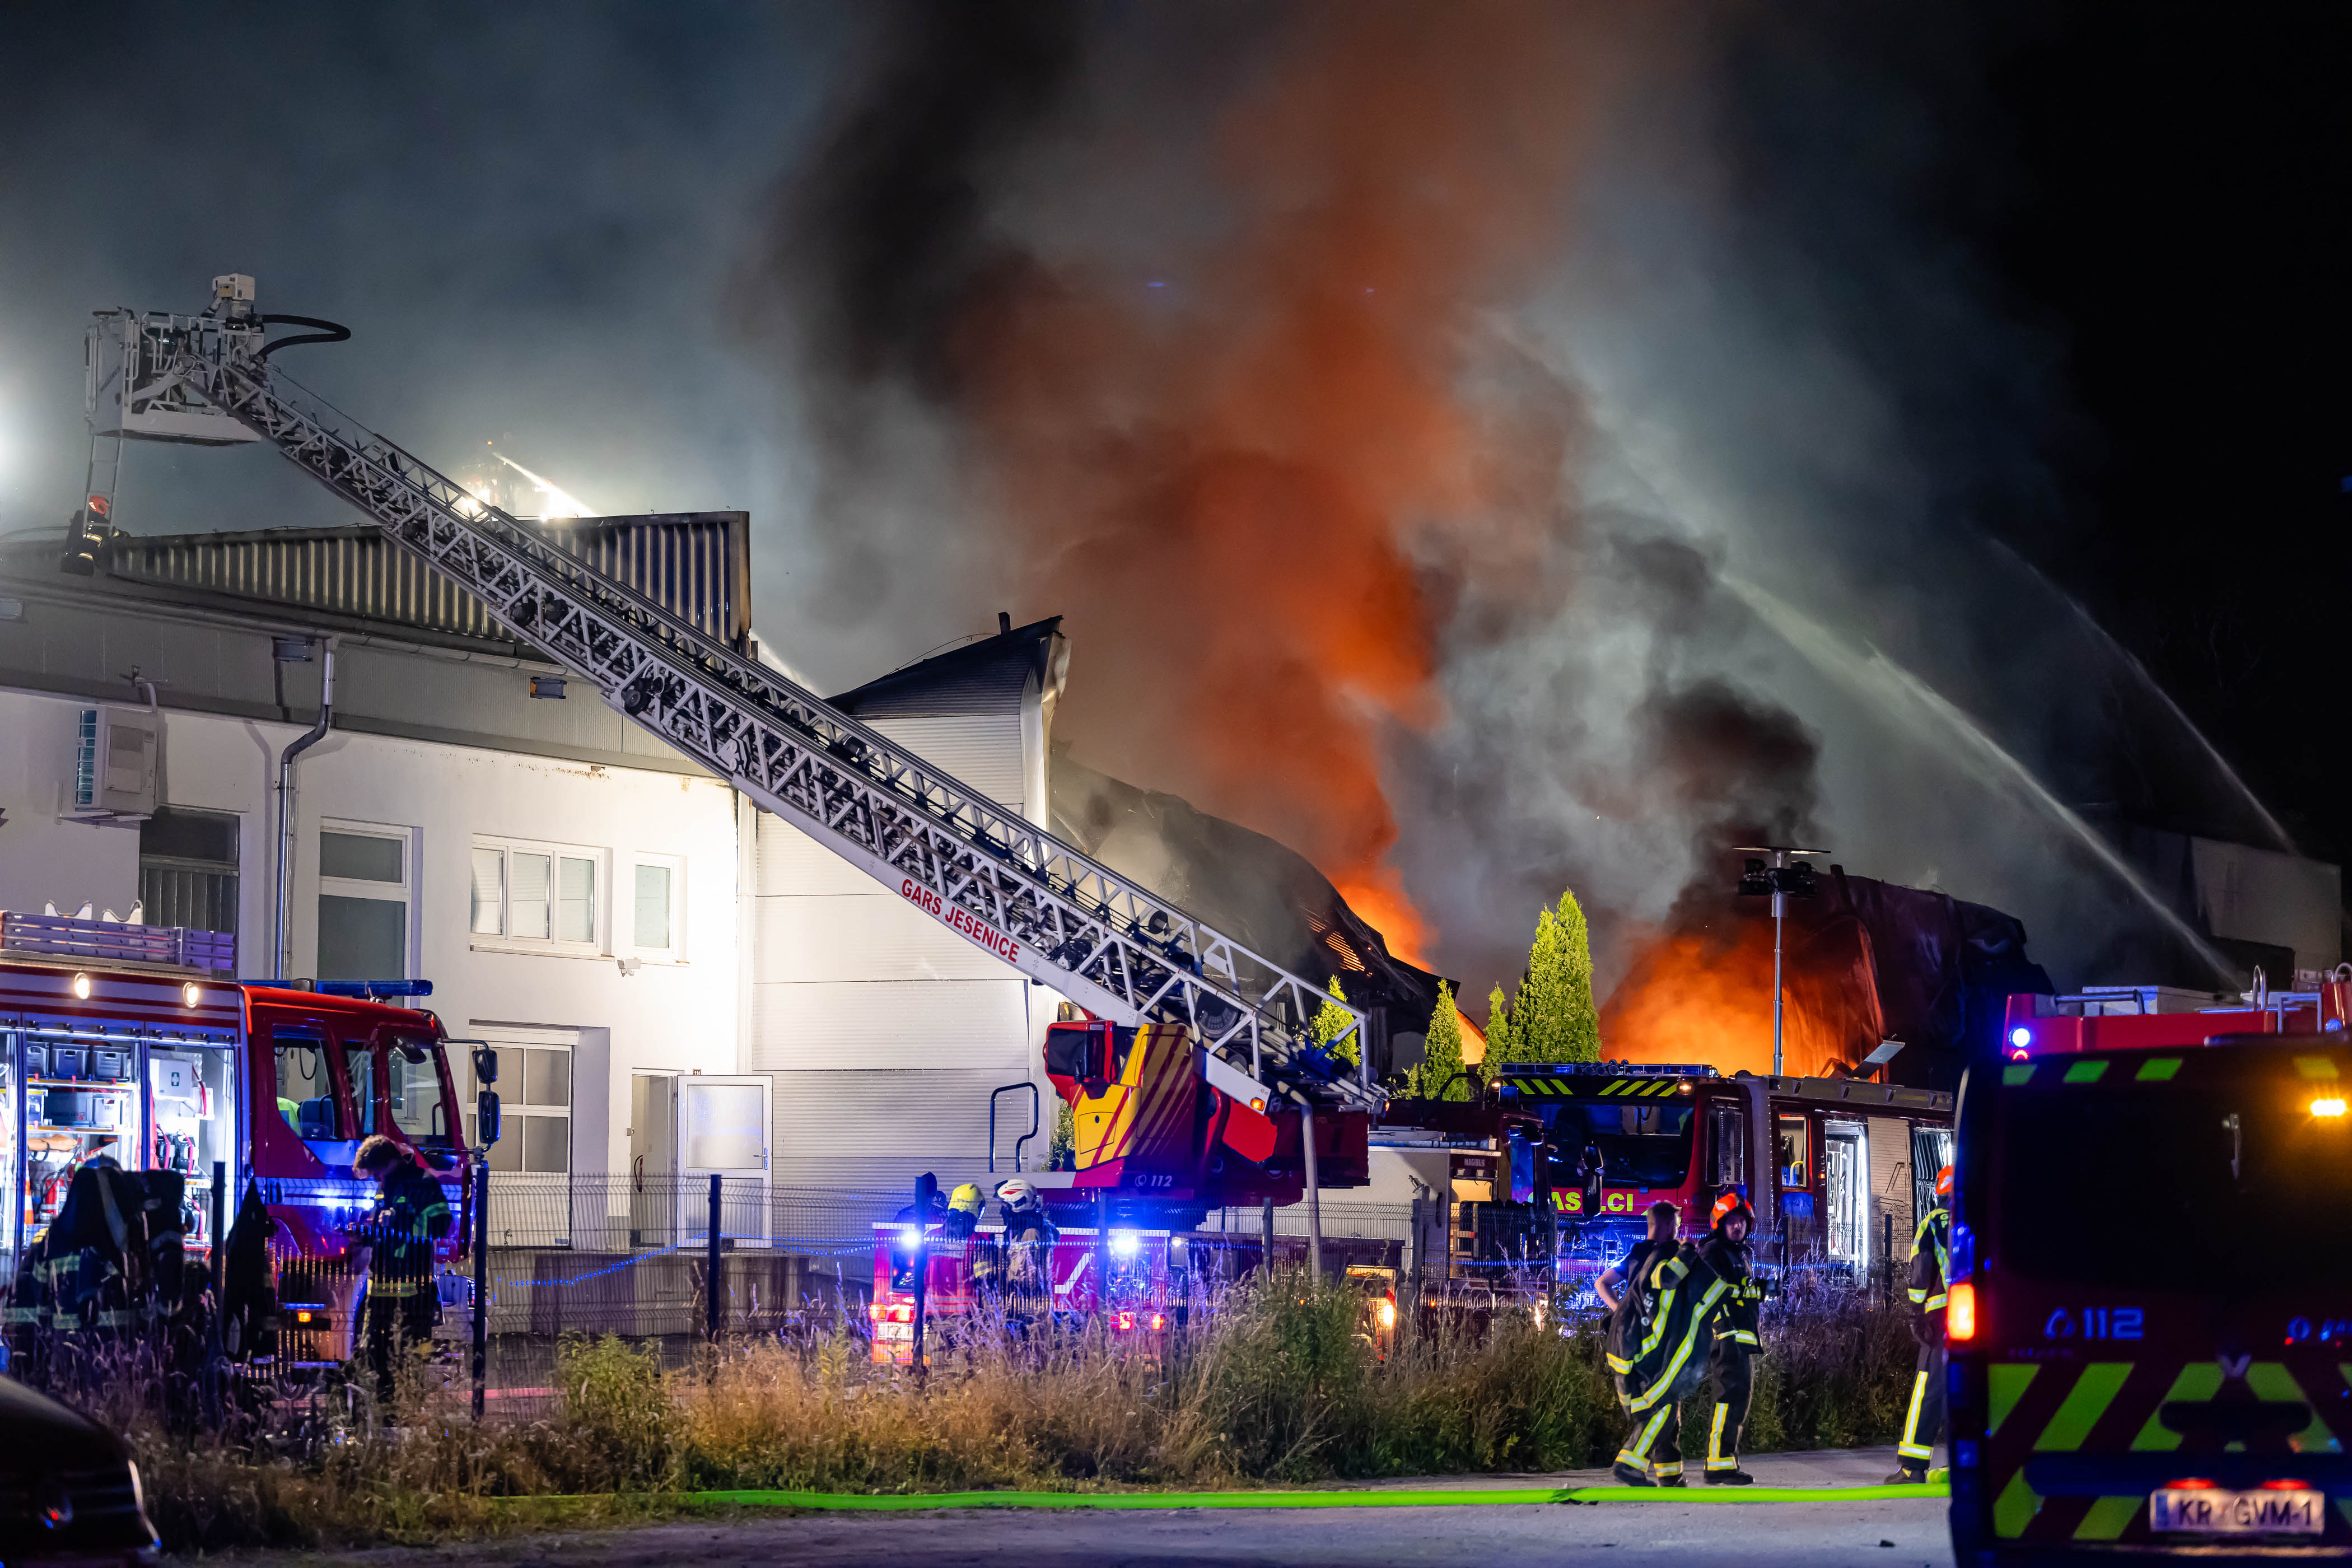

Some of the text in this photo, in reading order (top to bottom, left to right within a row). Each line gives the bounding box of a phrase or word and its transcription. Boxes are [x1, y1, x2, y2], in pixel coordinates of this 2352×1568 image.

[902, 879, 1020, 963] GARS JESENICE
[1464, 1158, 1485, 1166] MAGIRUS
[1151, 1175, 1173, 1187] 112
[2083, 1307, 2144, 1340] 112
[2178, 1499, 2212, 1525] KR
